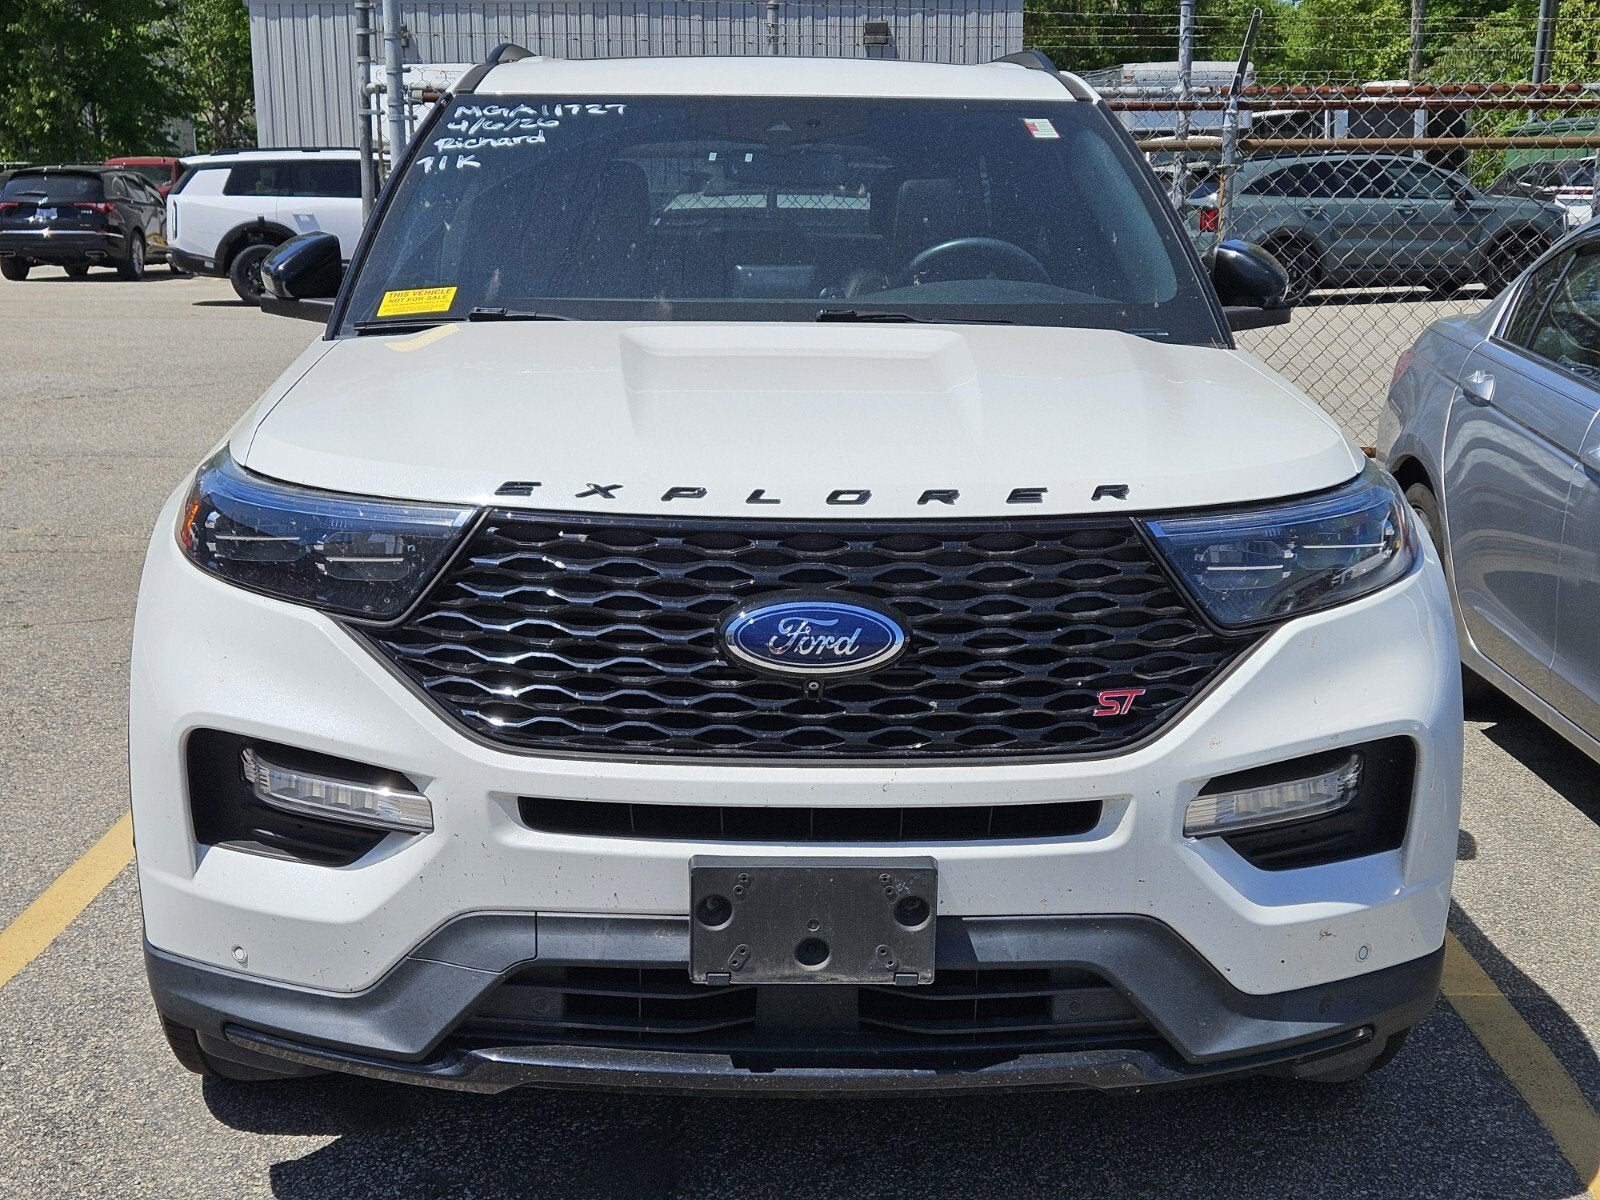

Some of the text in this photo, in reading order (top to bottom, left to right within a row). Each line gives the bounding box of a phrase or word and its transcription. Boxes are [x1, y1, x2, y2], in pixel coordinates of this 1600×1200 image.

[434, 130, 546, 152] Richard
[494, 481, 1131, 506] EXPLORER
[768, 616, 862, 655] Ford
[1093, 689, 1146, 716] ST
